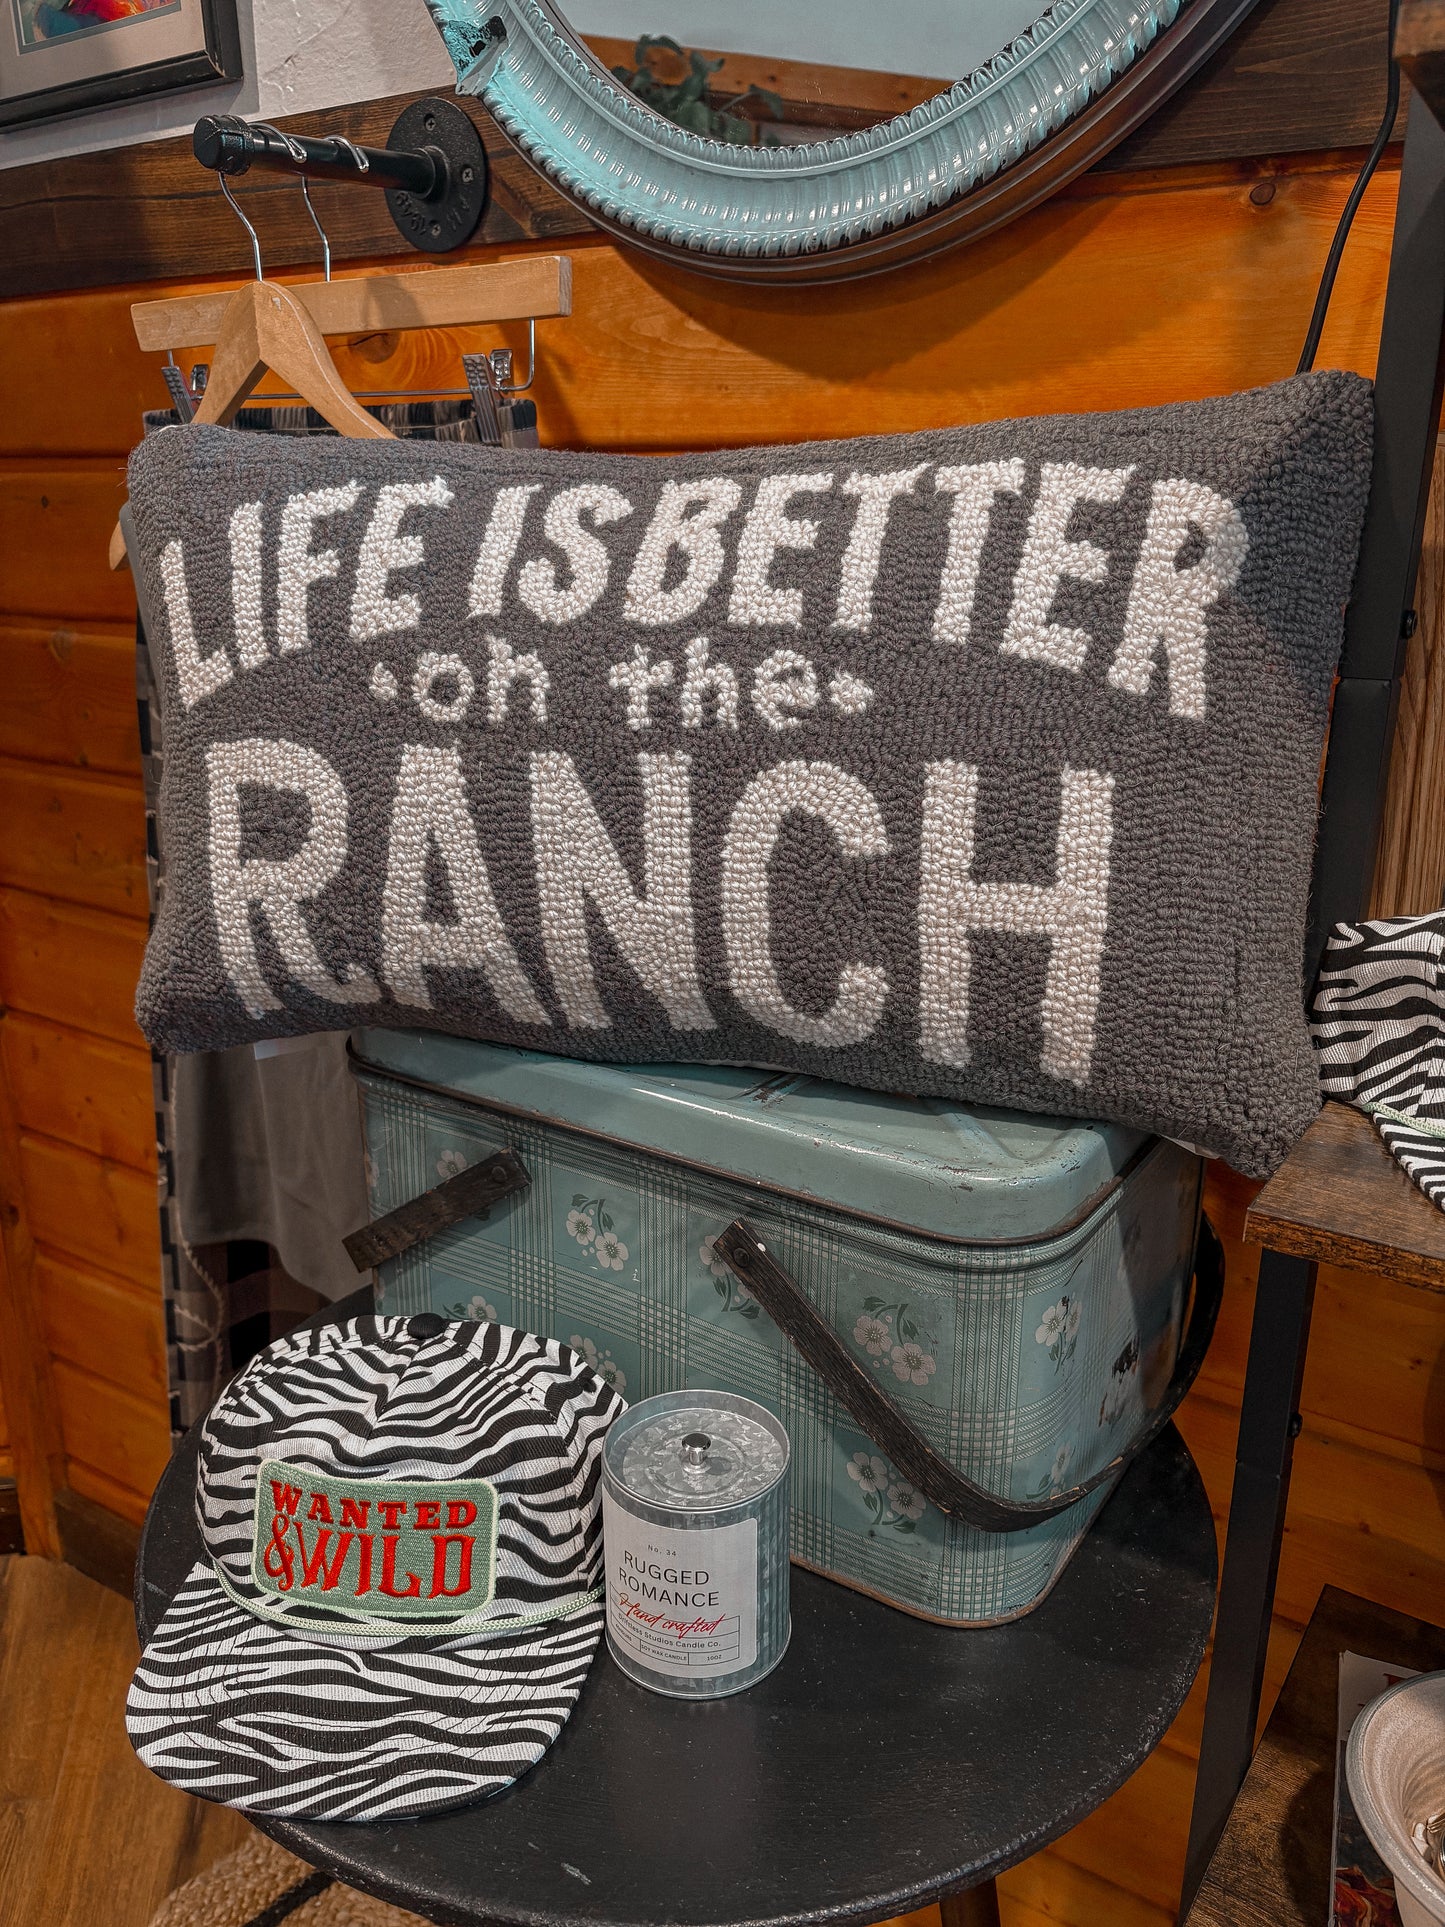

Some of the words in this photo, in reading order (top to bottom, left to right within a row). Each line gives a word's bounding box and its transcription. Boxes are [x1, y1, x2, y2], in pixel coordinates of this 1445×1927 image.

[159, 476, 454, 712] LIFE
[467, 483, 633, 626] IS
[623, 457, 1249, 720] BETTER
[413, 636, 550, 723] on
[609, 637, 818, 731] the
[204, 738, 1116, 1087] RANCH
[270, 1480, 477, 1530] WANTED
[624, 1550, 709, 1585] RUGGED
[647, 1544, 662, 1555] No.
[666, 1549, 677, 1557] 34
[619, 1567, 720, 1607] ROMANCE
[644, 1631, 674, 1646] Studios
[675, 1640, 705, 1649] Candle
[662, 1613, 726, 1639] crafted
[664, 1653, 687, 1661] CANDLE
